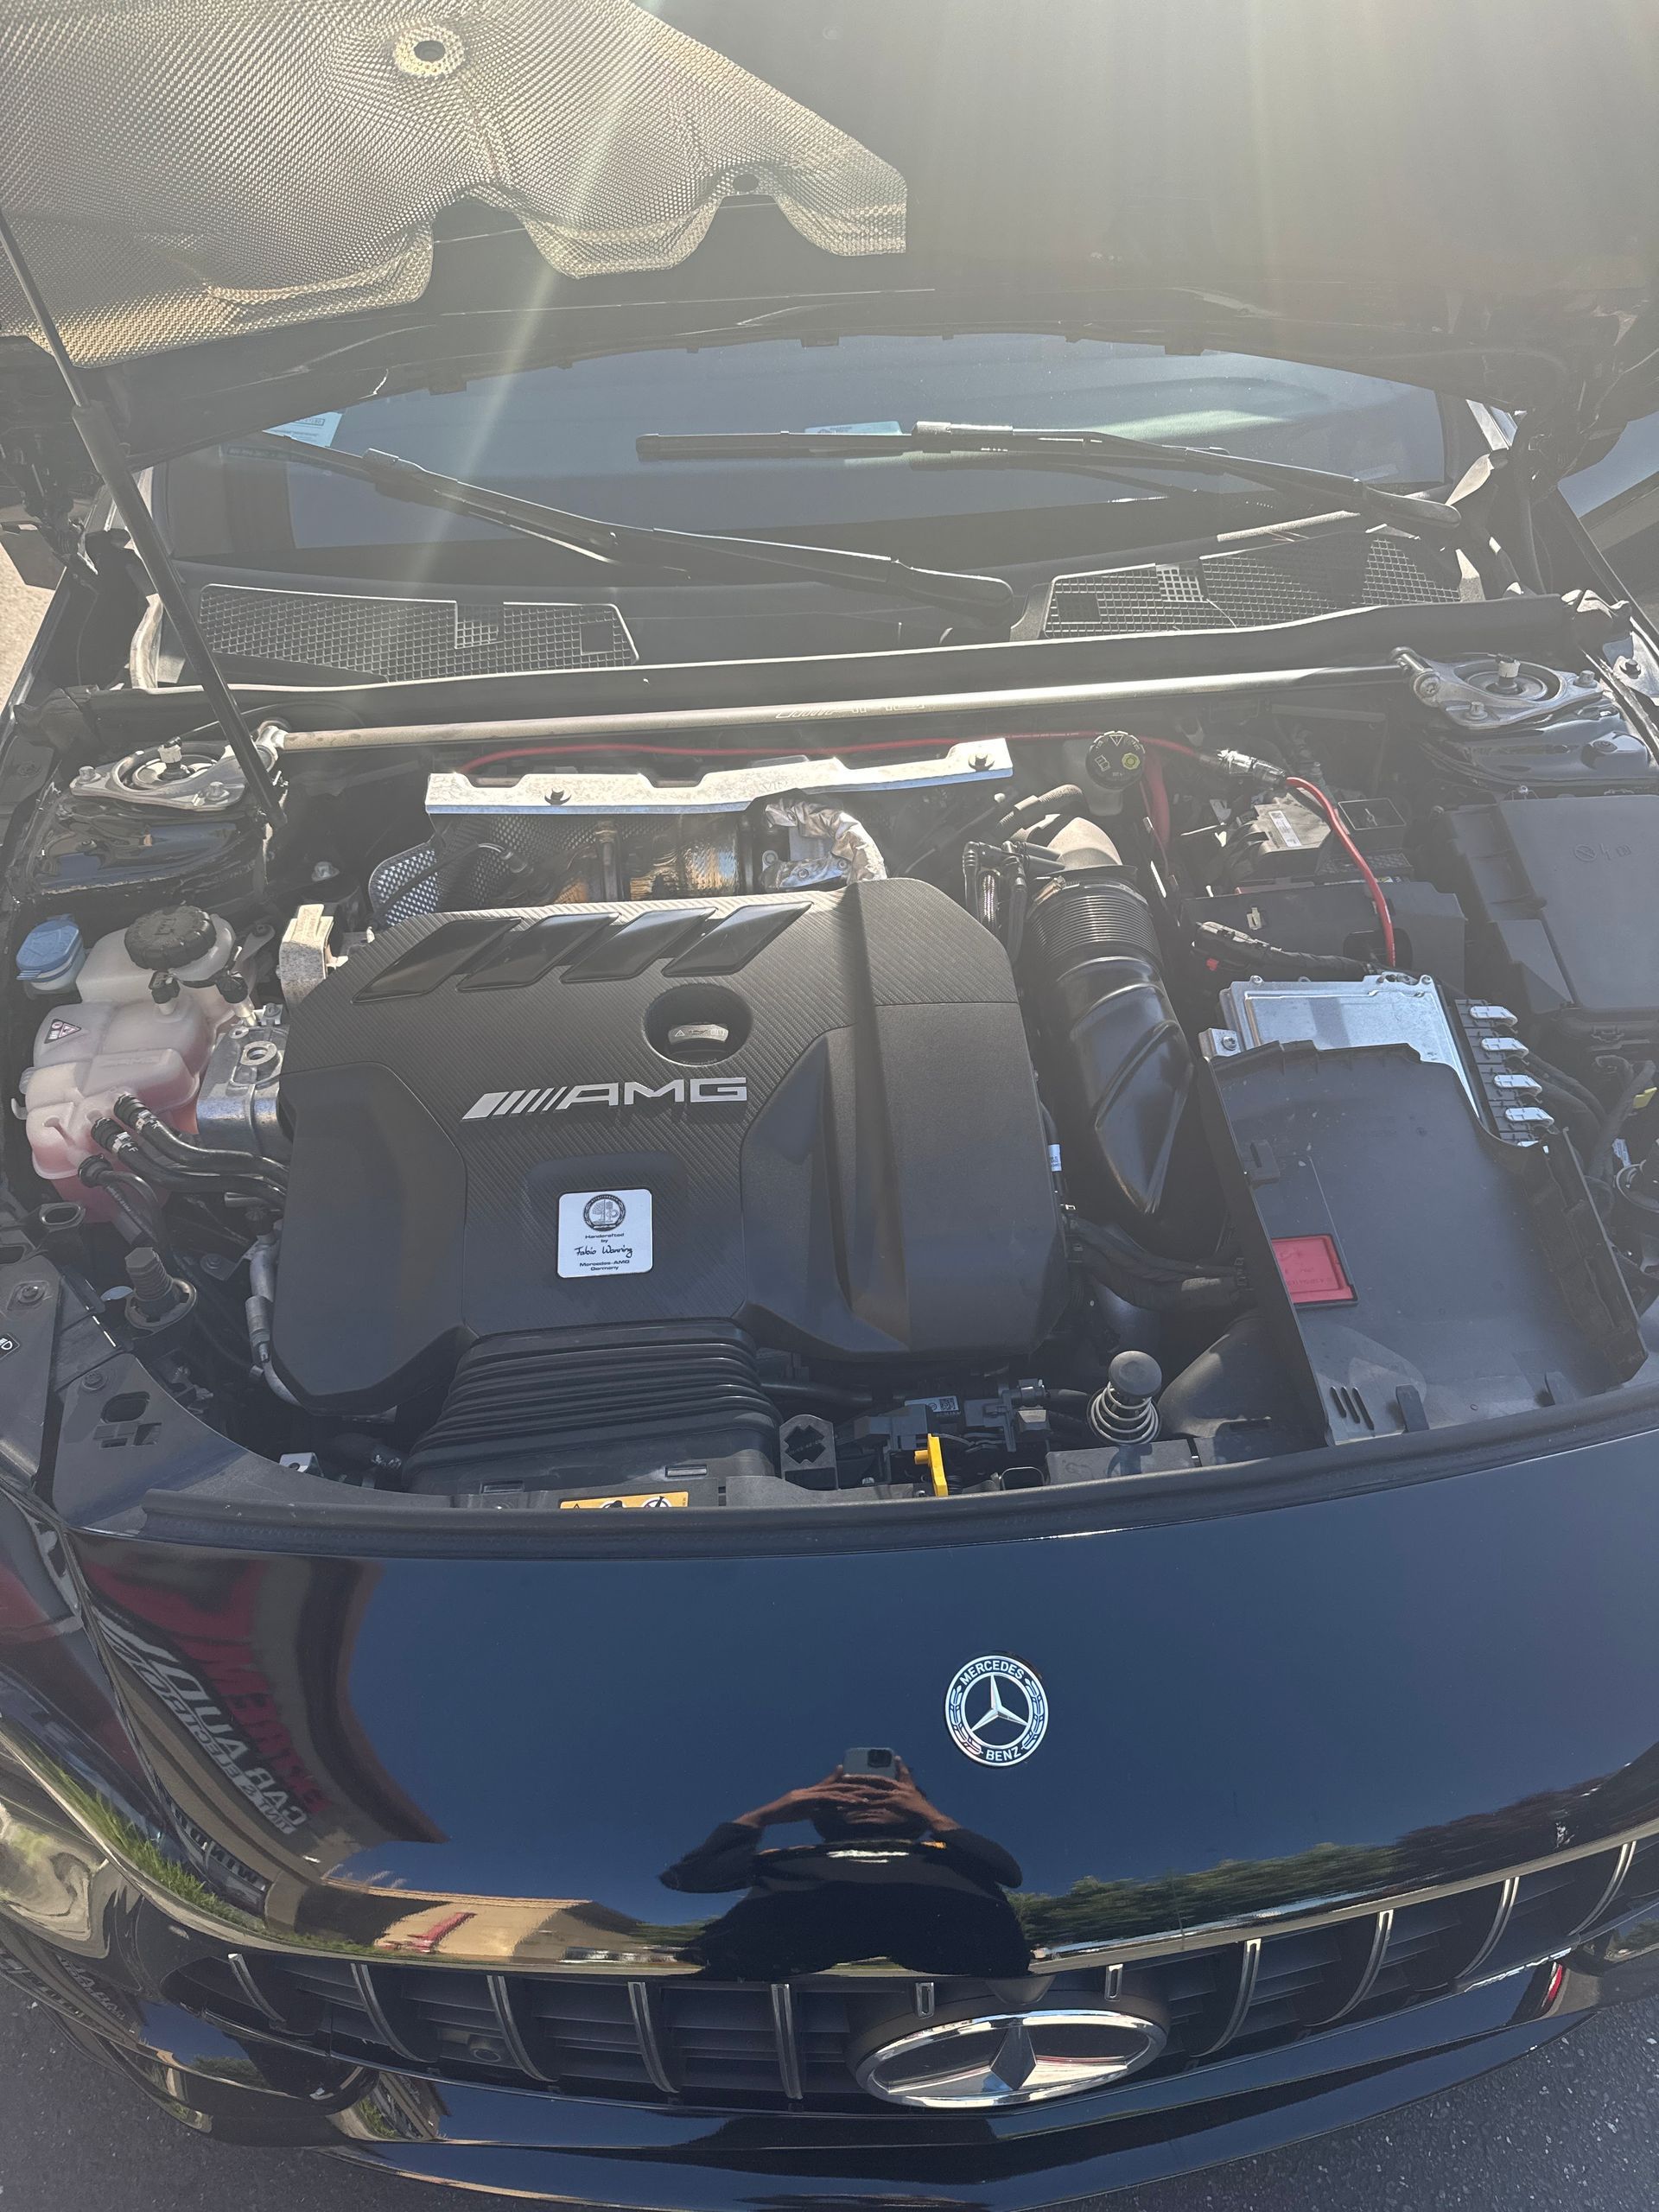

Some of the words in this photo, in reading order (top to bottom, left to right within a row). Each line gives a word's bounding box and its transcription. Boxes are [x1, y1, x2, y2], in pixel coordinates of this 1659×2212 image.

[555, 1077, 747, 1111] AMG
[575, 1245, 597, 1257] Fabio
[959, 1660, 1025, 1686] MERCEDES
[985, 1745, 1021, 1761] BENZ
